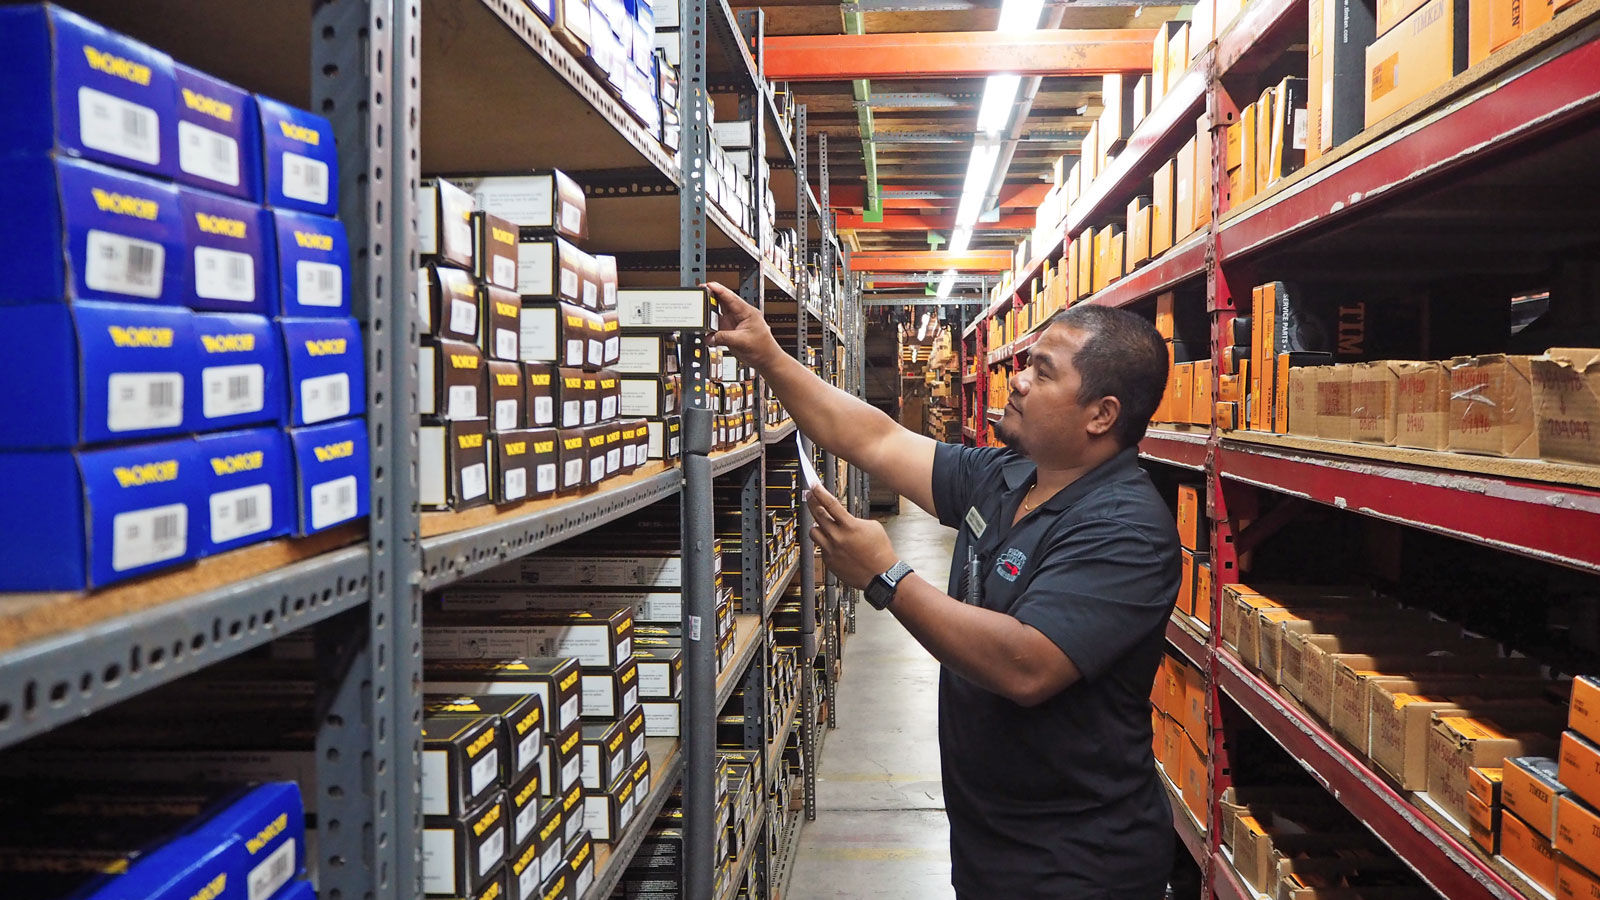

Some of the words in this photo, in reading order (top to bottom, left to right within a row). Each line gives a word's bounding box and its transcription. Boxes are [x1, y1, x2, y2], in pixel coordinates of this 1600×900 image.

[1412, 2, 1444, 36] TIMKEN
[1282, 293, 1290, 321] SERVICE
[1281, 322, 1289, 344] PARTS
